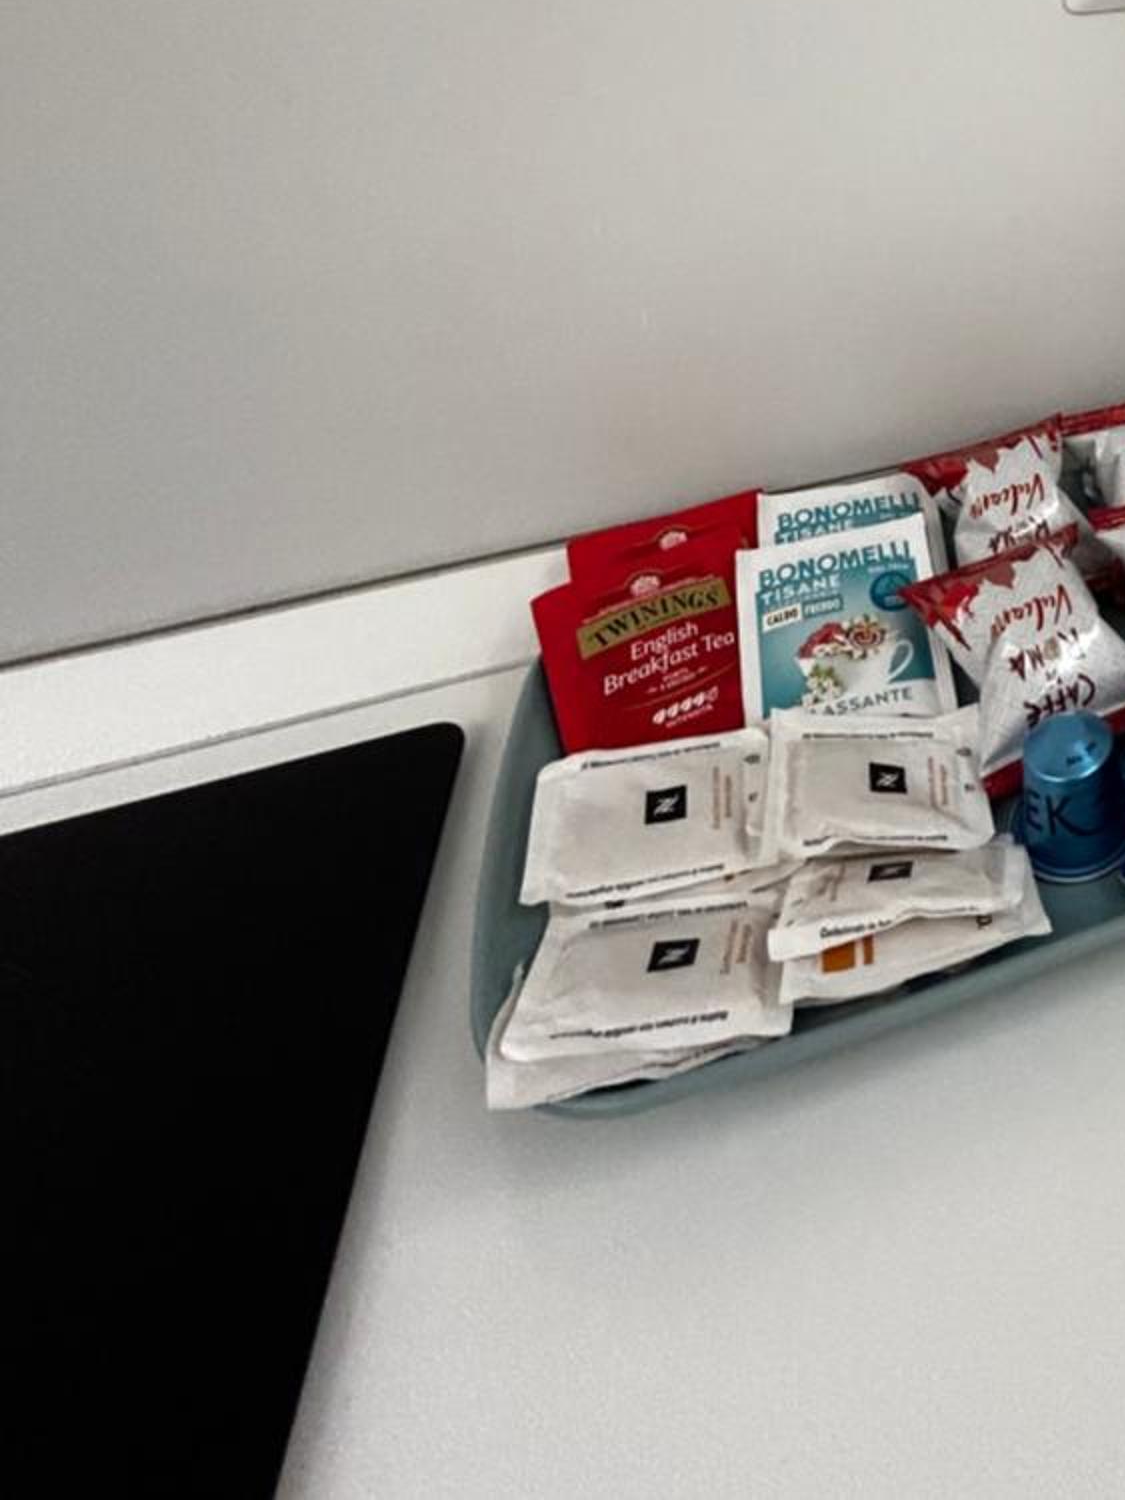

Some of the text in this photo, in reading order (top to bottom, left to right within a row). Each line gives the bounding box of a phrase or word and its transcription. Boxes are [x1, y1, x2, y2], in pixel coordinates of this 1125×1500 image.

[778, 491, 919, 533] BONOMELLI
[759, 540, 911, 591] BONOMELLI
[760, 573, 841, 605] TISANE
[588, 588, 720, 646] TWININGS
[603, 643, 699, 696] Breakfast
[702, 631, 735, 652] Tea
[630, 621, 699, 661] English
